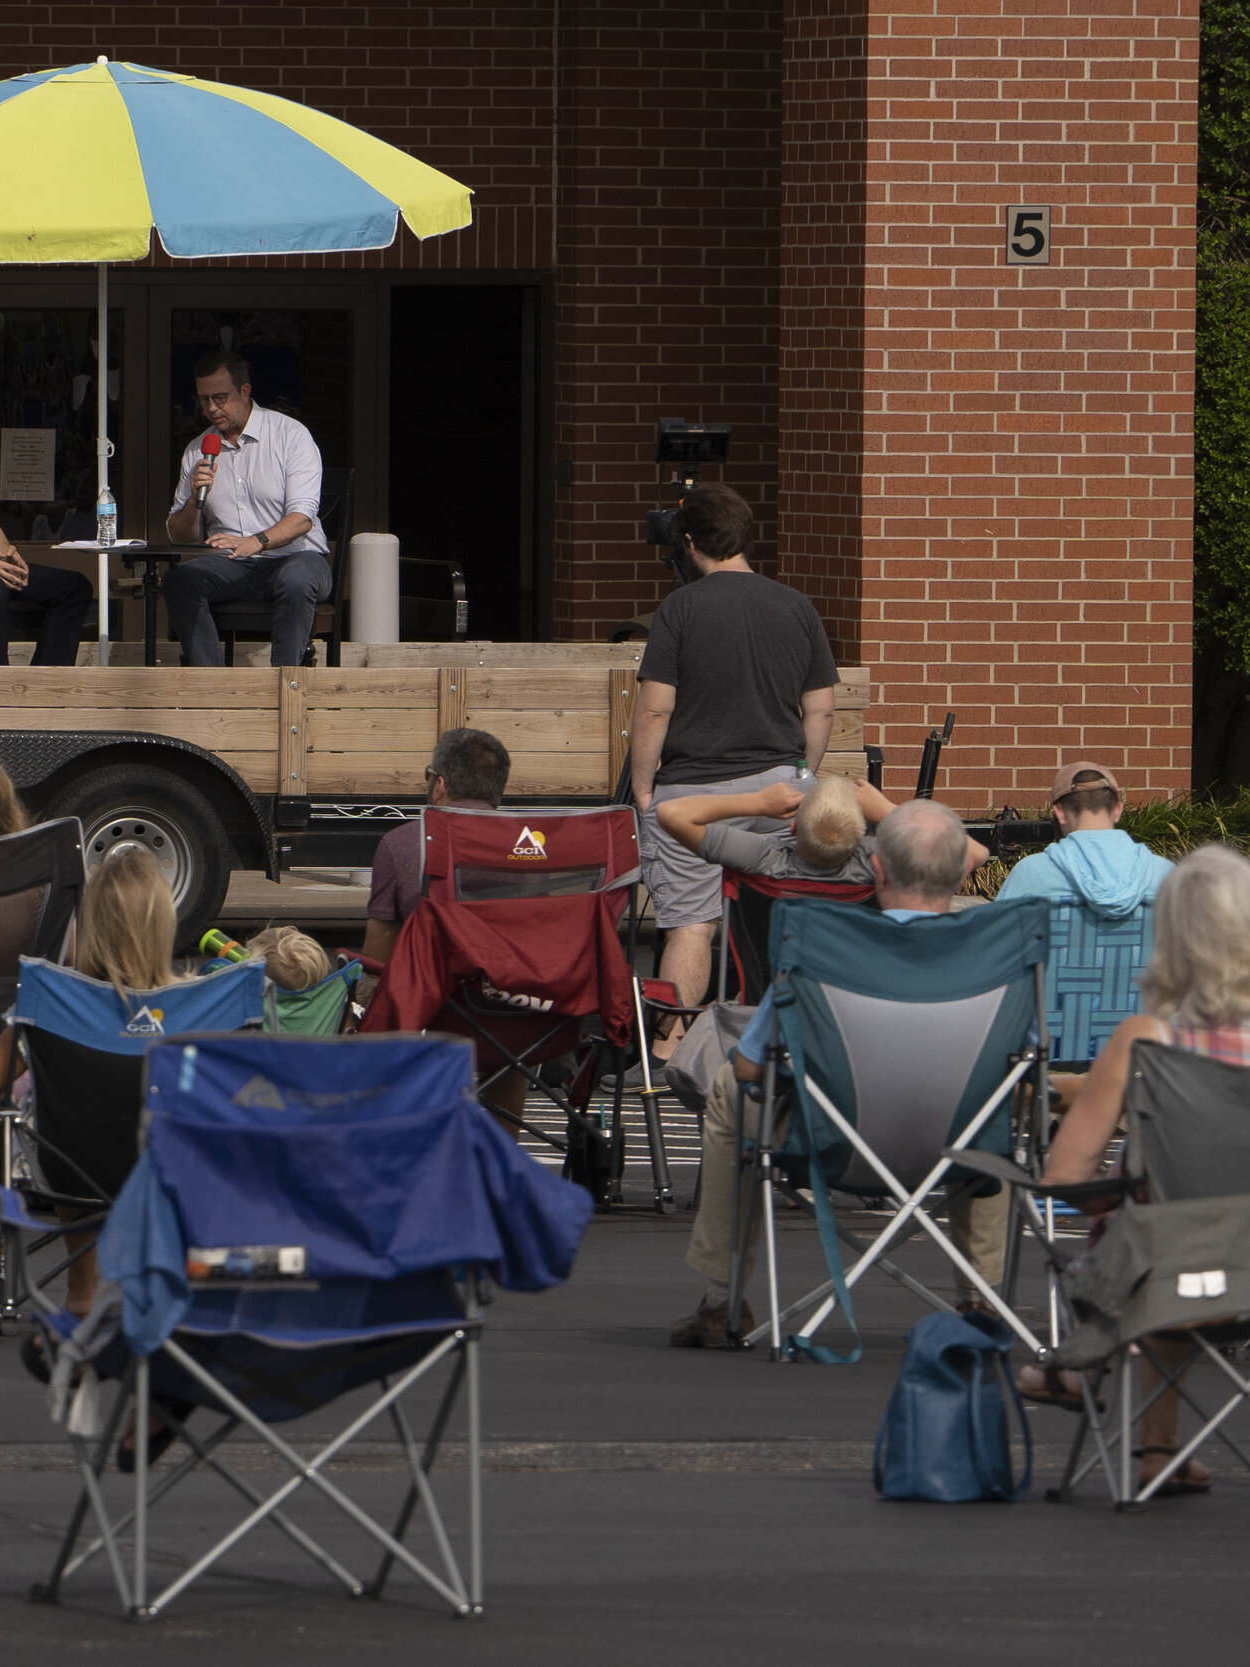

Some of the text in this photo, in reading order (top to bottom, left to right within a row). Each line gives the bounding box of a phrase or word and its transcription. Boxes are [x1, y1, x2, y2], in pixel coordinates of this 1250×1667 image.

[1011, 212, 1045, 257] 5
[512, 846, 538, 855] GCI
[126, 1022, 155, 1032] GCI
